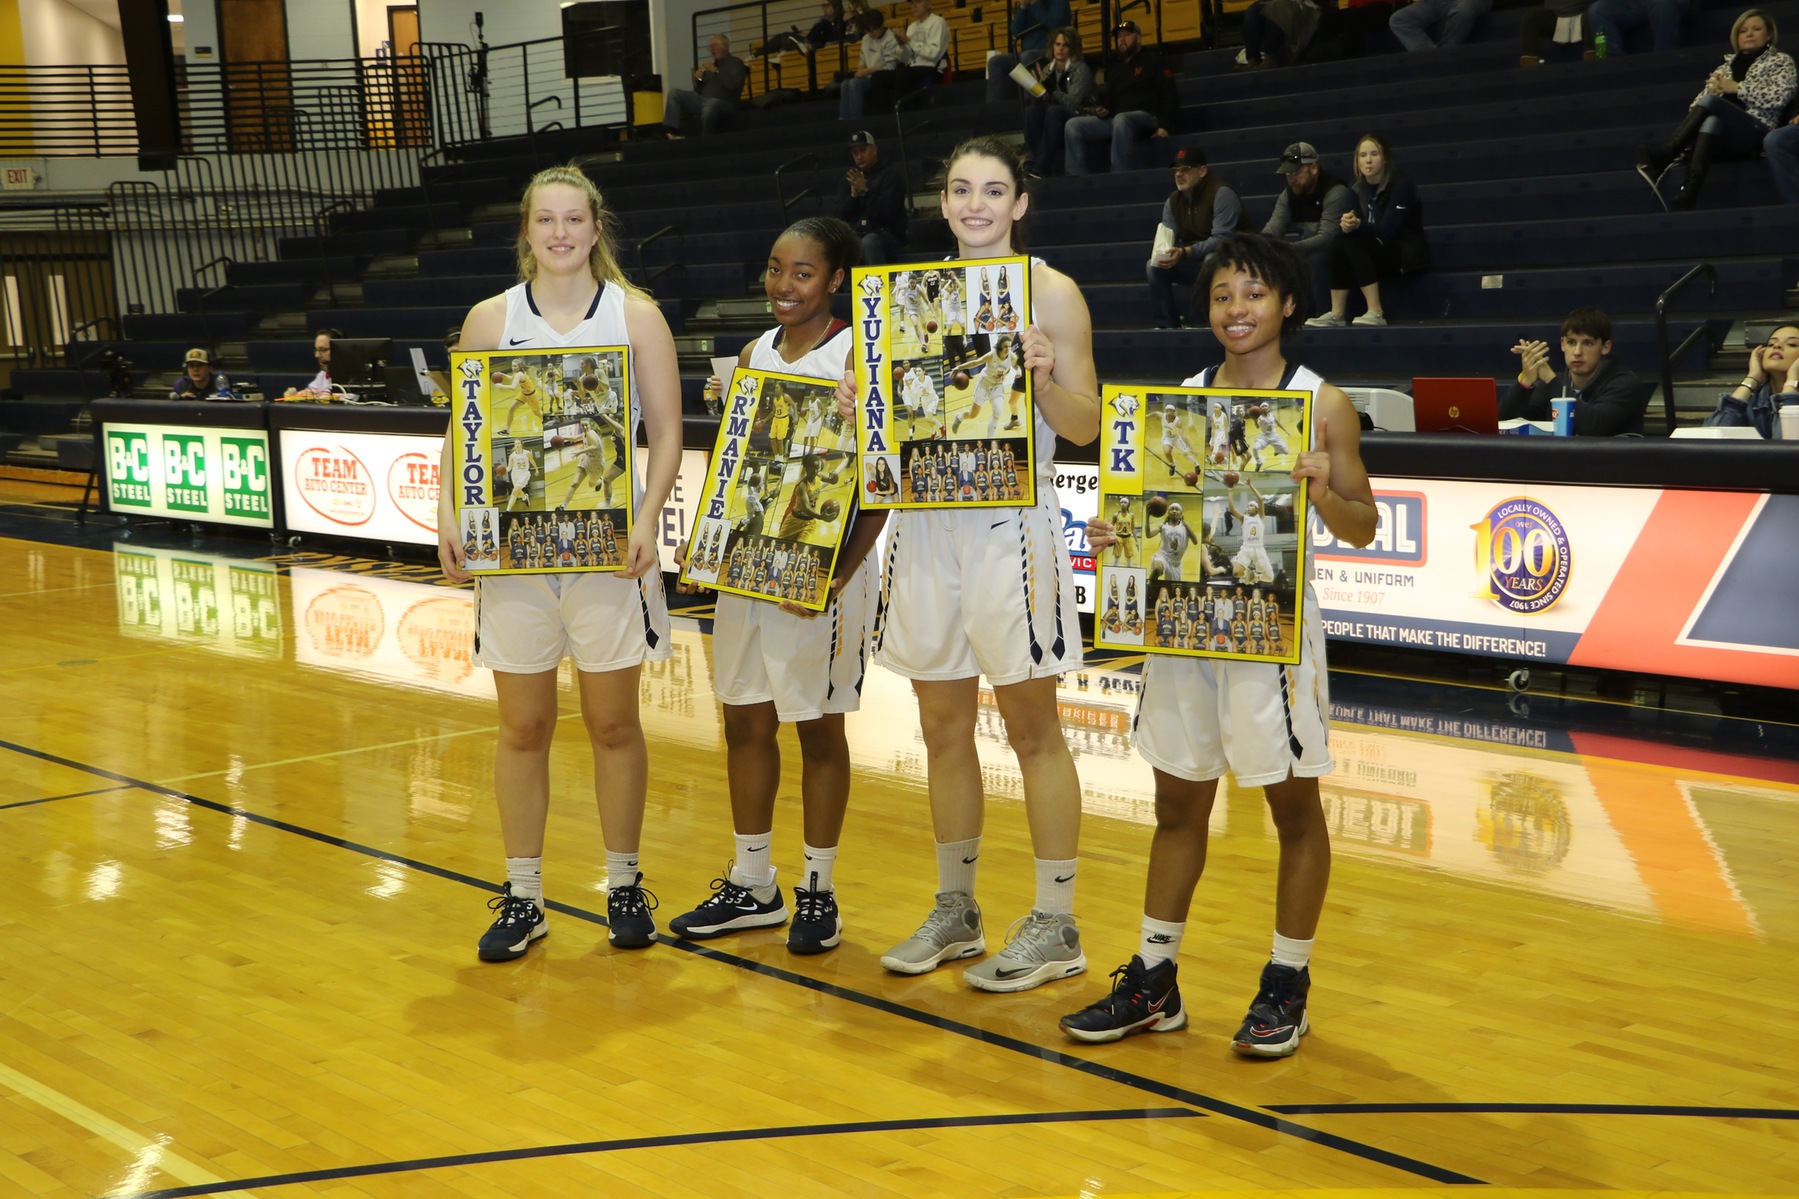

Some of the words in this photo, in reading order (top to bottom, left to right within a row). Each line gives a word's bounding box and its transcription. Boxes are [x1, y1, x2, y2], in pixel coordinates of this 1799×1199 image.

[7, 169, 28, 184] EXIT
[862, 297, 886, 452] YULIANA
[462, 379, 486, 506] TAYLOR
[1111, 421, 1136, 472] TK
[109, 437, 149, 482] B&C
[163, 440, 206, 487] B&C
[222, 443, 267, 492] B&C
[707, 395, 756, 520] R'MANIE
[312, 457, 358, 480] TEAM
[407, 463, 441, 485] TEA
[113, 483, 150, 501] STEEL
[305, 478, 327, 492] AUTO
[330, 480, 368, 496] CENTER
[398, 485, 425, 500] AUTO
[428, 487, 440, 501] CE
[1050, 473, 1098, 494] erge
[167, 487, 208, 506] STEEL
[225, 493, 268, 513] STEEL
[1497, 504, 1532, 519] LOCALLY
[1533, 506, 1561, 535] OWNED
[1557, 537, 1565, 545] &
[1468, 517, 1554, 601] 100
[1315, 568, 1333, 581] EN
[1339, 569, 1348, 583] &
[1355, 571, 1414, 588] UNIFORM
[1551, 546, 1568, 594] OPERATED
[1504, 576, 1543, 591] YEARS
[1322, 587, 1353, 602] Since
[1357, 590, 1386, 605] 1907
[1509, 600, 1529, 610] 1907
[1530, 592, 1554, 609] SINCE
[1321, 620, 1364, 638] PEOPLE
[1366, 624, 1397, 641] THAT
[1399, 628, 1434, 645] MAKE
[1435, 632, 1461, 648] THE
[1463, 635, 1546, 657] DIFFERENCE!
[1152, 933, 1172, 942] NIKE
